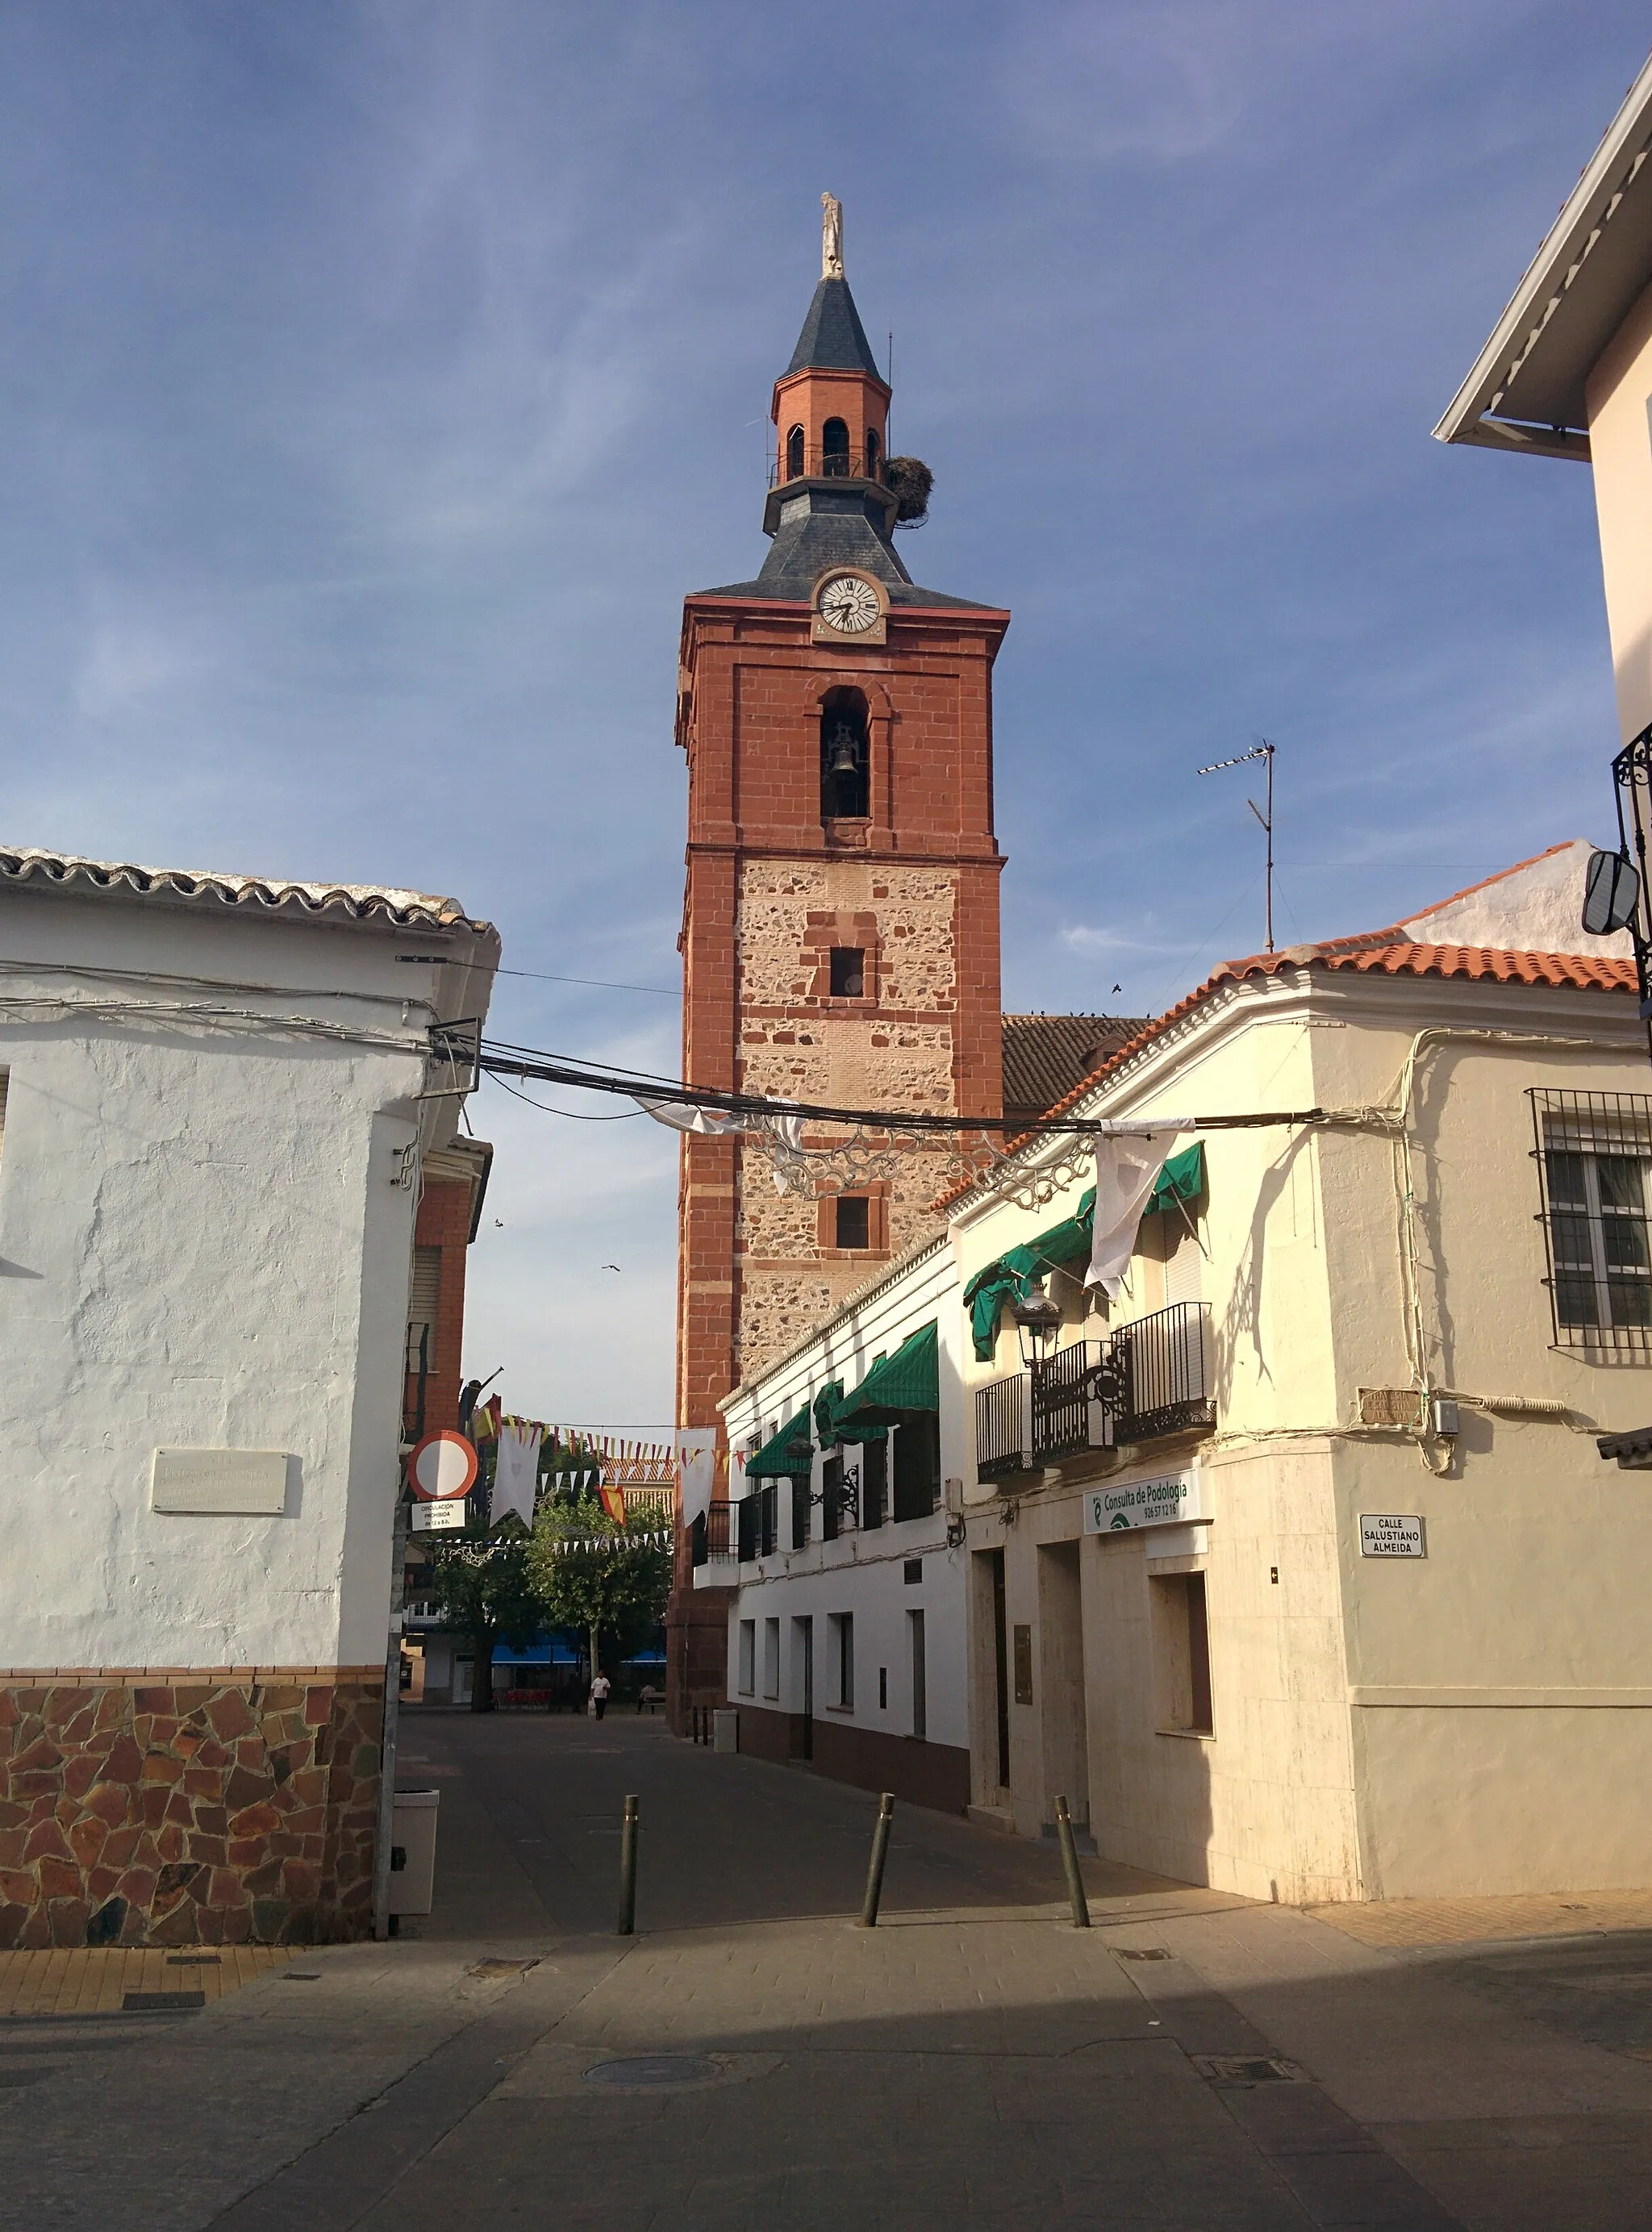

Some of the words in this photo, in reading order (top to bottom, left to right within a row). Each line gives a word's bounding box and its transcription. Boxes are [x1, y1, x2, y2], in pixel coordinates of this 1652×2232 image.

[1104, 1489, 1136, 1511] Consulta
[1136, 1487, 1145, 1504] de
[1146, 1479, 1187, 1504] Podología
[1145, 1507, 1153, 1518] 926
[1155, 1506, 1161, 1517] 57
[1162, 1505, 1169, 1516] 12
[1170, 1504, 1176, 1515] 16
[1379, 1519, 1403, 1529] CALLE
[1364, 1531, 1419, 1541] SALUSTIANO
[1374, 1543, 1412, 1553] ALMEIDA
